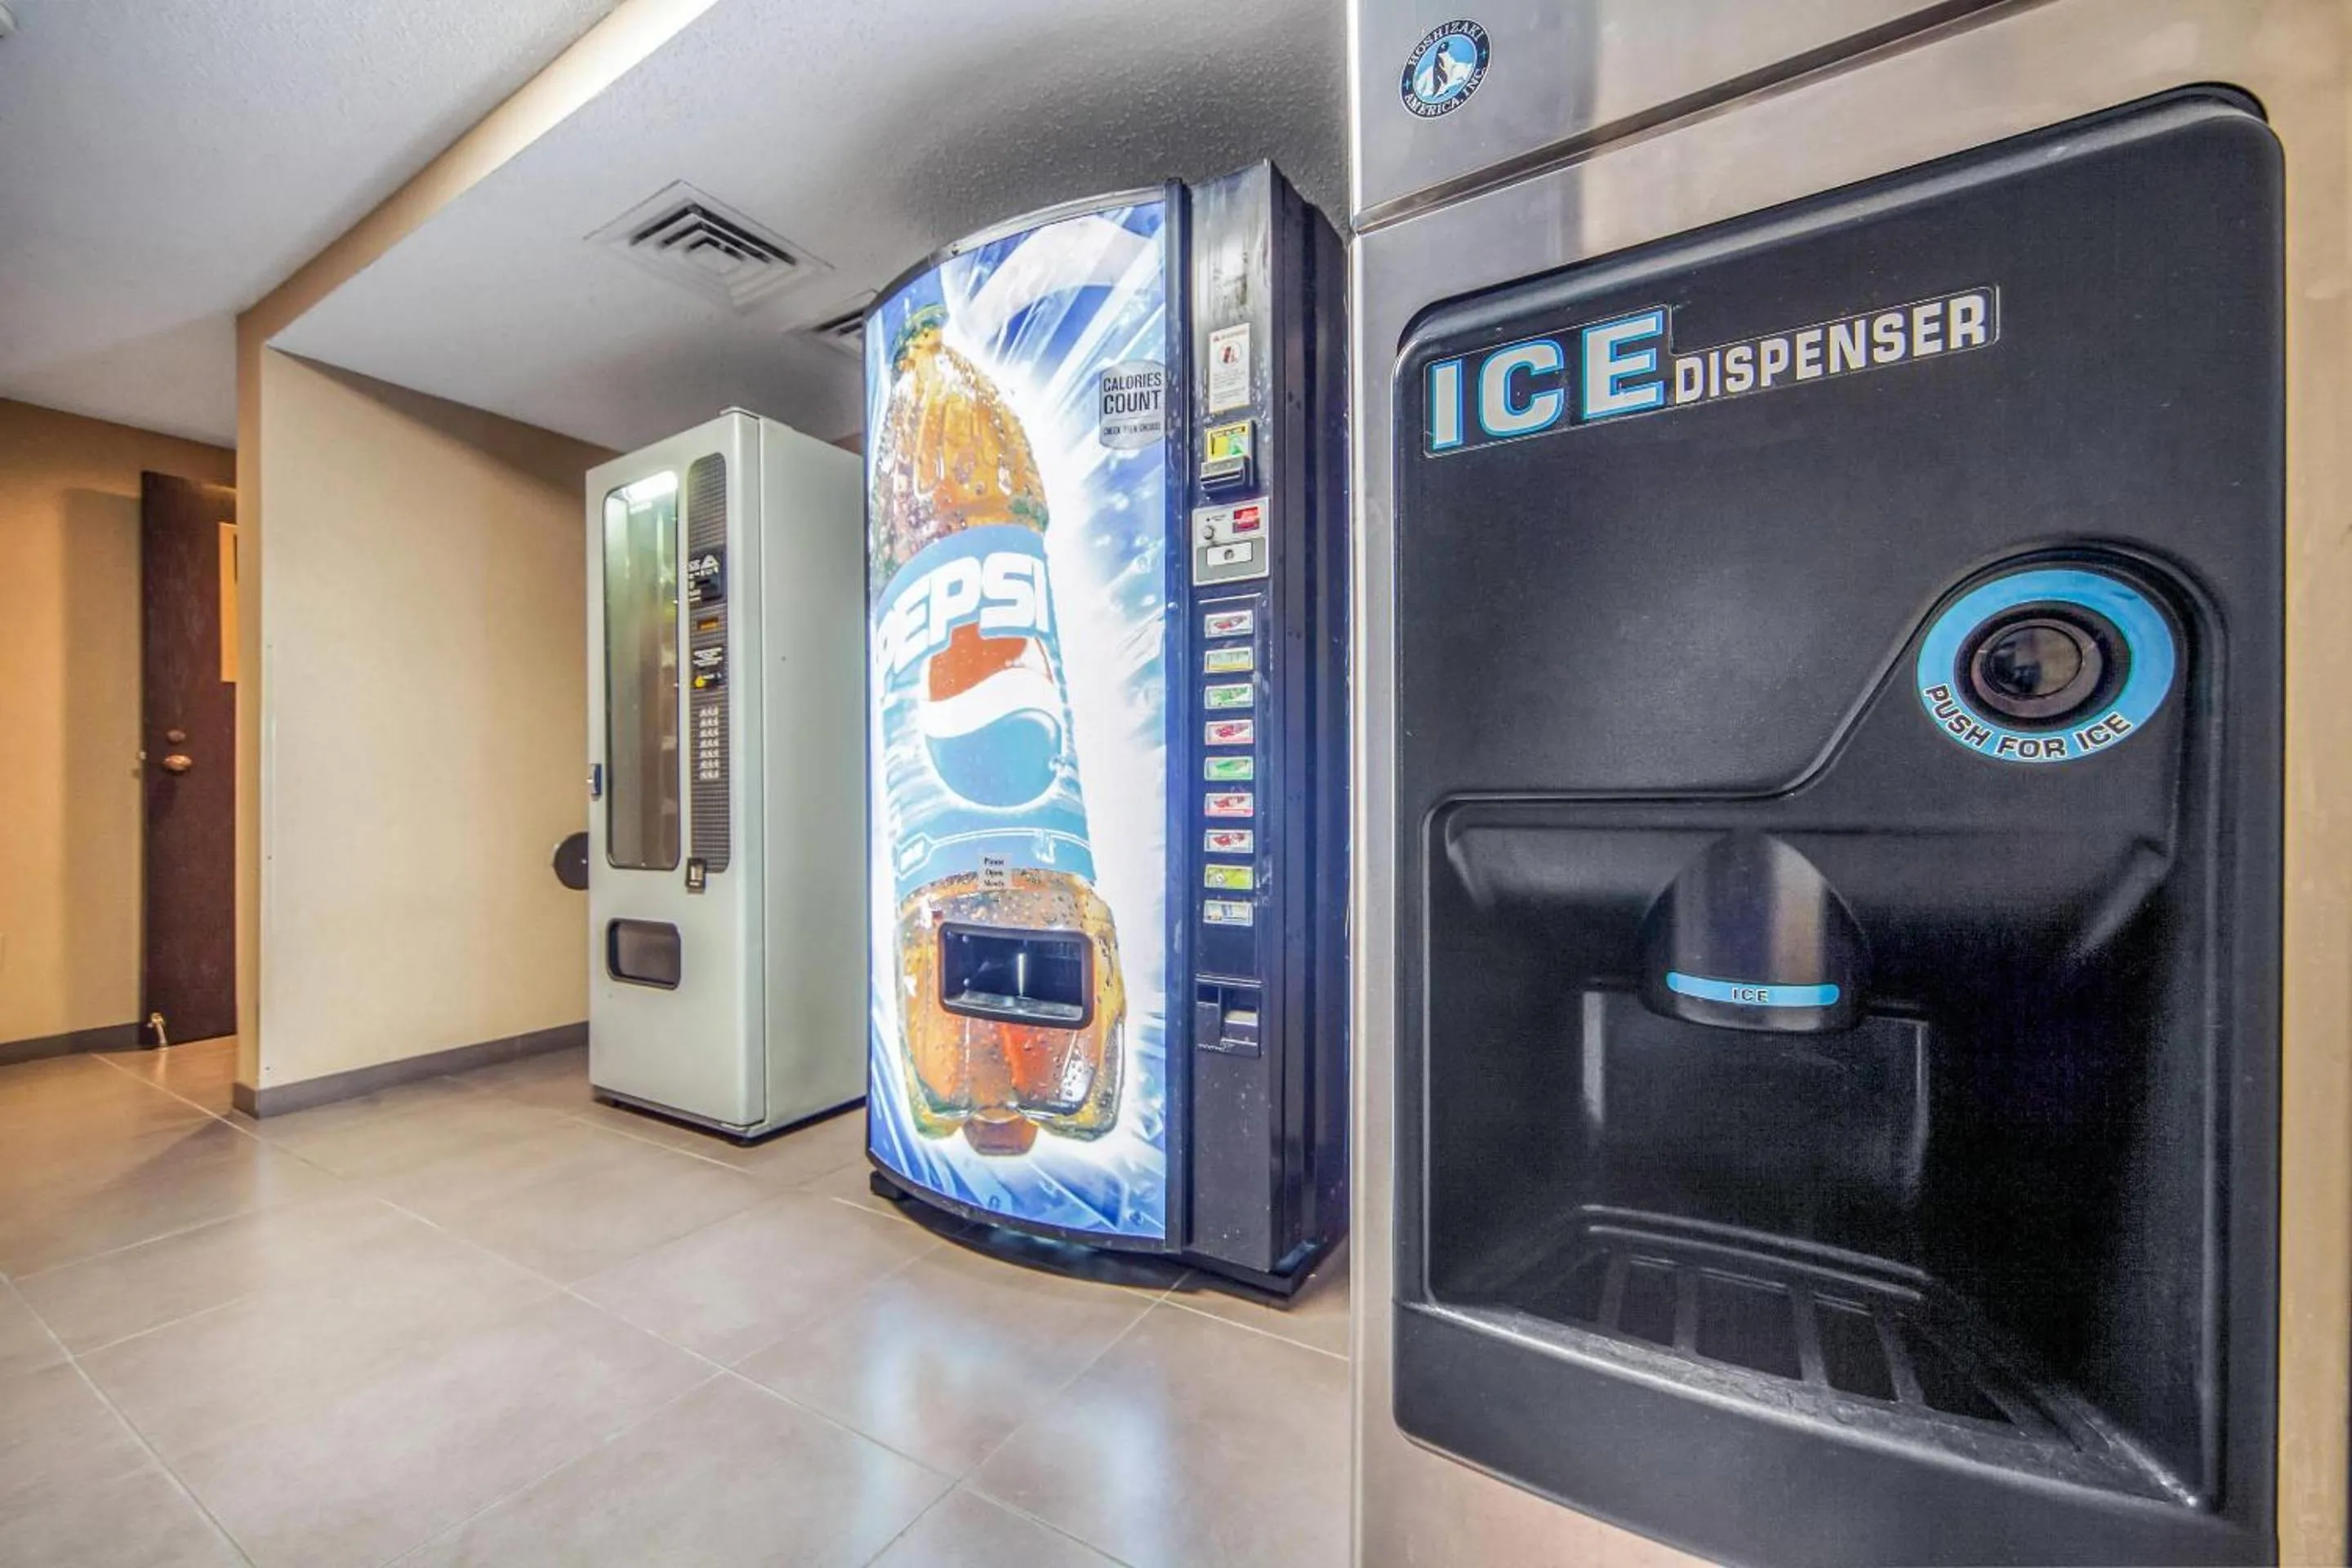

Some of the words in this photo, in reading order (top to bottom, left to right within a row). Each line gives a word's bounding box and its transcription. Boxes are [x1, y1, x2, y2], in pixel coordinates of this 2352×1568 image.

[1407, 21, 1485, 66] HOSHIZAKI
[1103, 372, 1161, 393] CALORIES
[1432, 310, 1665, 451] ICE
[1675, 294, 1986, 404] DISPENSER
[1103, 390, 1161, 414] COUNT
[876, 551, 1050, 676] PEPSI
[1924, 683, 1993, 748] PUSH
[1995, 734, 2067, 760] FOR
[2072, 711, 2133, 752] ICE
[1731, 987, 1769, 1002] ICE
